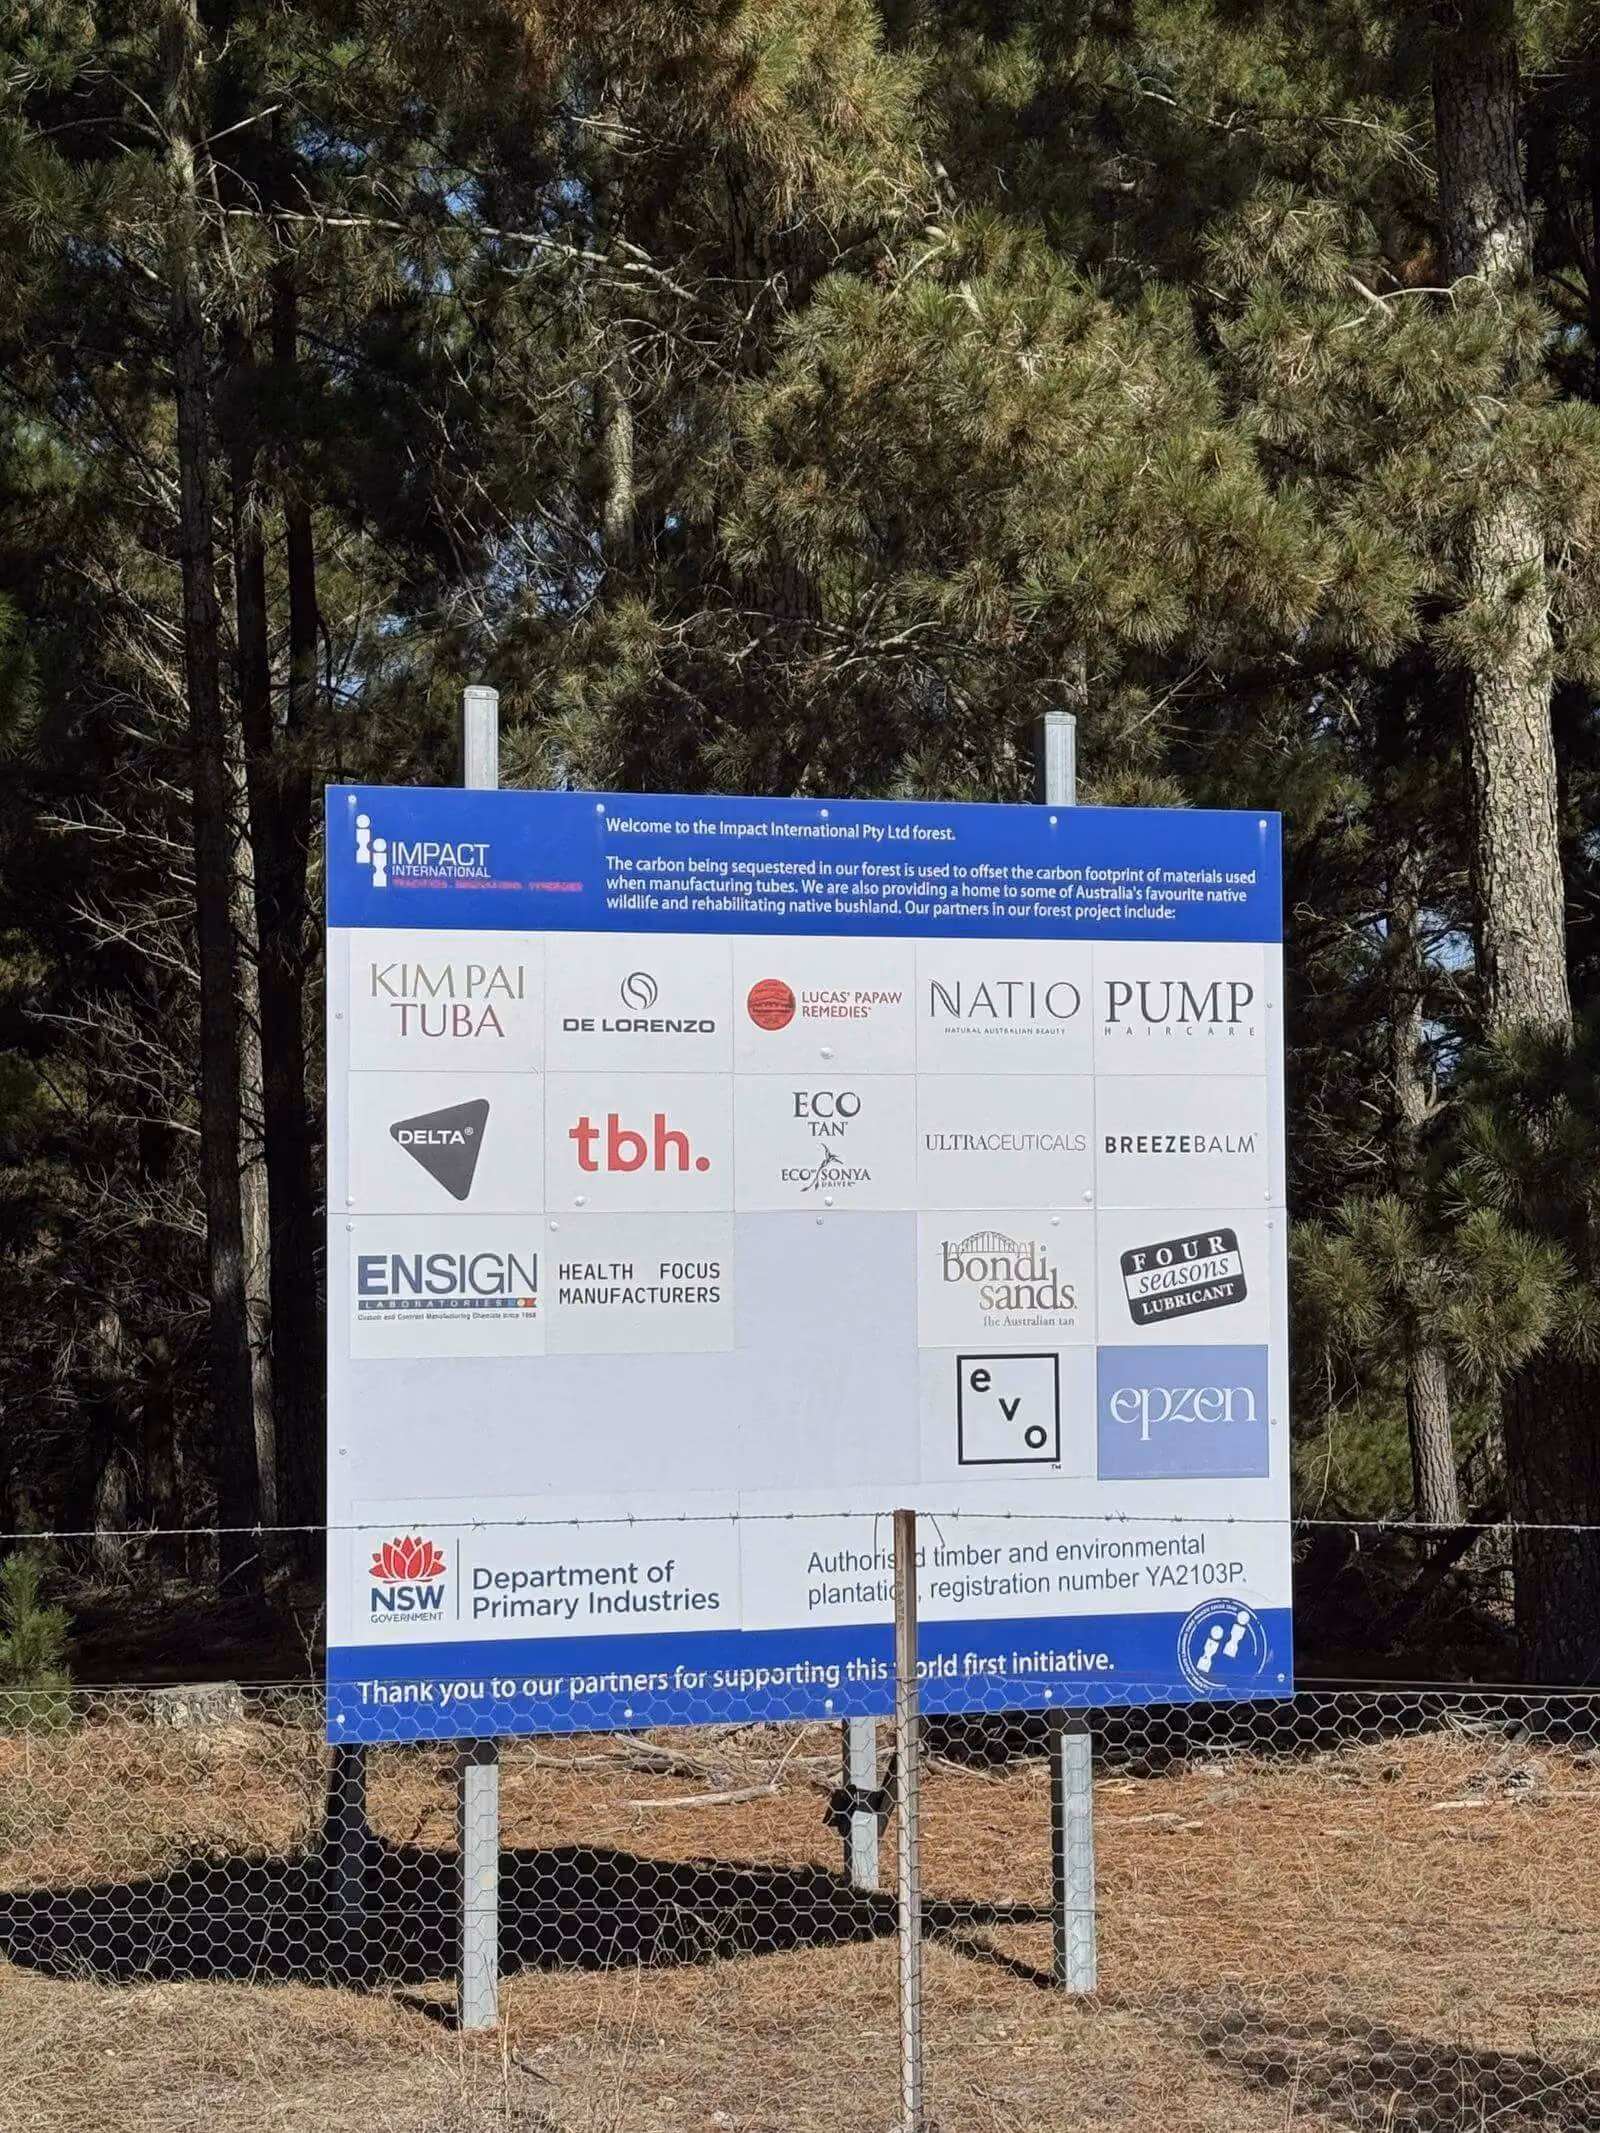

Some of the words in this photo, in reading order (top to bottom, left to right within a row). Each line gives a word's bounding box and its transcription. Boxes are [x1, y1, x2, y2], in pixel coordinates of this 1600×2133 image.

[606, 817, 671, 833] Welcome
[675, 821, 690, 834] to
[693, 820, 716, 835] the
[720, 821, 768, 838] Impact
[771, 822, 859, 838] International
[863, 824, 884, 842] Pty
[888, 825, 909, 839] Ltd
[913, 825, 956, 840] forest.
[391, 842, 491, 867] IMPACT
[392, 865, 492, 878] INTERNATIONAL
[606, 856, 633, 871] The
[636, 857, 685, 872] carbon
[688, 858, 728, 876] being
[732, 860, 815, 877] sequestered
[819, 861, 832, 875] in
[835, 864, 859, 876] our
[862, 862, 901, 877] forest
[904, 862, 915, 876] is
[918, 864, 950, 878] used
[953, 866, 967, 878] to
[970, 864, 1008, 879] offset
[1011, 865, 1033, 880] the
[1036, 865, 1082, 881] carbon
[1086, 866, 1144, 884] footprint
[1147, 868, 1161, 882] of
[1164, 869, 1222, 883] materials
[1225, 870, 1256, 884] used
[606, 875, 646, 890] when
[650, 876, 753, 896] manufacturing
[756, 879, 798, 894] tubes.
[802, 880, 823, 894] We
[827, 884, 848, 895] are
[852, 880, 879, 895] also
[882, 882, 947, 900] providing
[951, 887, 959, 897] a
[962, 882, 1000, 898] home
[1004, 884, 1017, 898] to
[1020, 887, 1056, 899] some
[1060, 884, 1073, 899] of
[1076, 885, 1143, 900] Australia's
[1146, 886, 1204, 901] favourite
[1207, 887, 1247, 902] native
[606, 894, 658, 910] wildlife
[661, 895, 688, 910] and
[692, 896, 786, 915] rehabilitating
[790, 899, 832, 913] native
[836, 899, 901, 914] bushland.
[905, 900, 929, 914] Our
[933, 901, 989, 918] partners
[992, 902, 1005, 916] in
[1008, 904, 1030, 917] our
[1033, 903, 1072, 918] forest
[1075, 903, 1121, 921] project
[1125, 904, 1176, 919] include:
[855, 992, 903, 1005] PAPAW
[928, 979, 1081, 1019] NATIO
[1104, 981, 1255, 1023] PUMP
[390, 1003, 505, 1037] TUBA
[563, 1018, 595, 1032] DE
[602, 1018, 716, 1033] LORENZO
[793, 1091, 861, 1118] ECO
[569, 1113, 710, 1172] tbh.
[925, 1134, 1086, 1151] ULTRACEUTICALS
[821, 1168, 872, 1181] SONYA
[942, 1240, 1050, 1282] bondi
[1132, 1235, 1226, 1273] FOUR
[358, 1253, 538, 1295] ENSIGN
[559, 1264, 633, 1281] HEALTH
[660, 1263, 720, 1280] FOCUS
[1140, 1256, 1230, 1294] seasons
[365, 1299, 502, 1310] LABORATORIES
[559, 1287, 720, 1304] MANUFACTURERS
[1142, 1283, 1235, 1316] LUBRICANT
[1003, 1315, 1055, 1327] Australian
[1058, 1317, 1075, 1326] tan
[1110, 1387, 1258, 1441] epzen
[808, 1546, 925, 1573] Authorisd
[934, 1545, 1001, 1567] timber
[1009, 1541, 1048, 1563] and
[1056, 1533, 1205, 1561] environmental
[473, 1563, 638, 1592] Department
[647, 1560, 675, 1583] of
[930, 1568, 1050, 1602] registration
[1058, 1568, 1139, 1592] number
[1146, 1561, 1247, 1587] YA2103P.
[371, 1585, 444, 1612] NSW
[473, 1594, 579, 1620] Primary
[590, 1588, 720, 1614] Industries
[370, 1611, 444, 1624] GOVERNMENT
[358, 1680, 432, 1705] Thank
[439, 1680, 485, 1707] you
[493, 1677, 516, 1697] to
[522, 1677, 564, 1696] our
[569, 1671, 668, 1700] partners
[673, 1665, 707, 1689] for
[713, 1661, 840, 1691] supporting
[846, 1658, 888, 1681] this
[893, 1653, 957, 1679] orld
[964, 1652, 1006, 1676] first
[1012, 1650, 1115, 1675] initiative.
